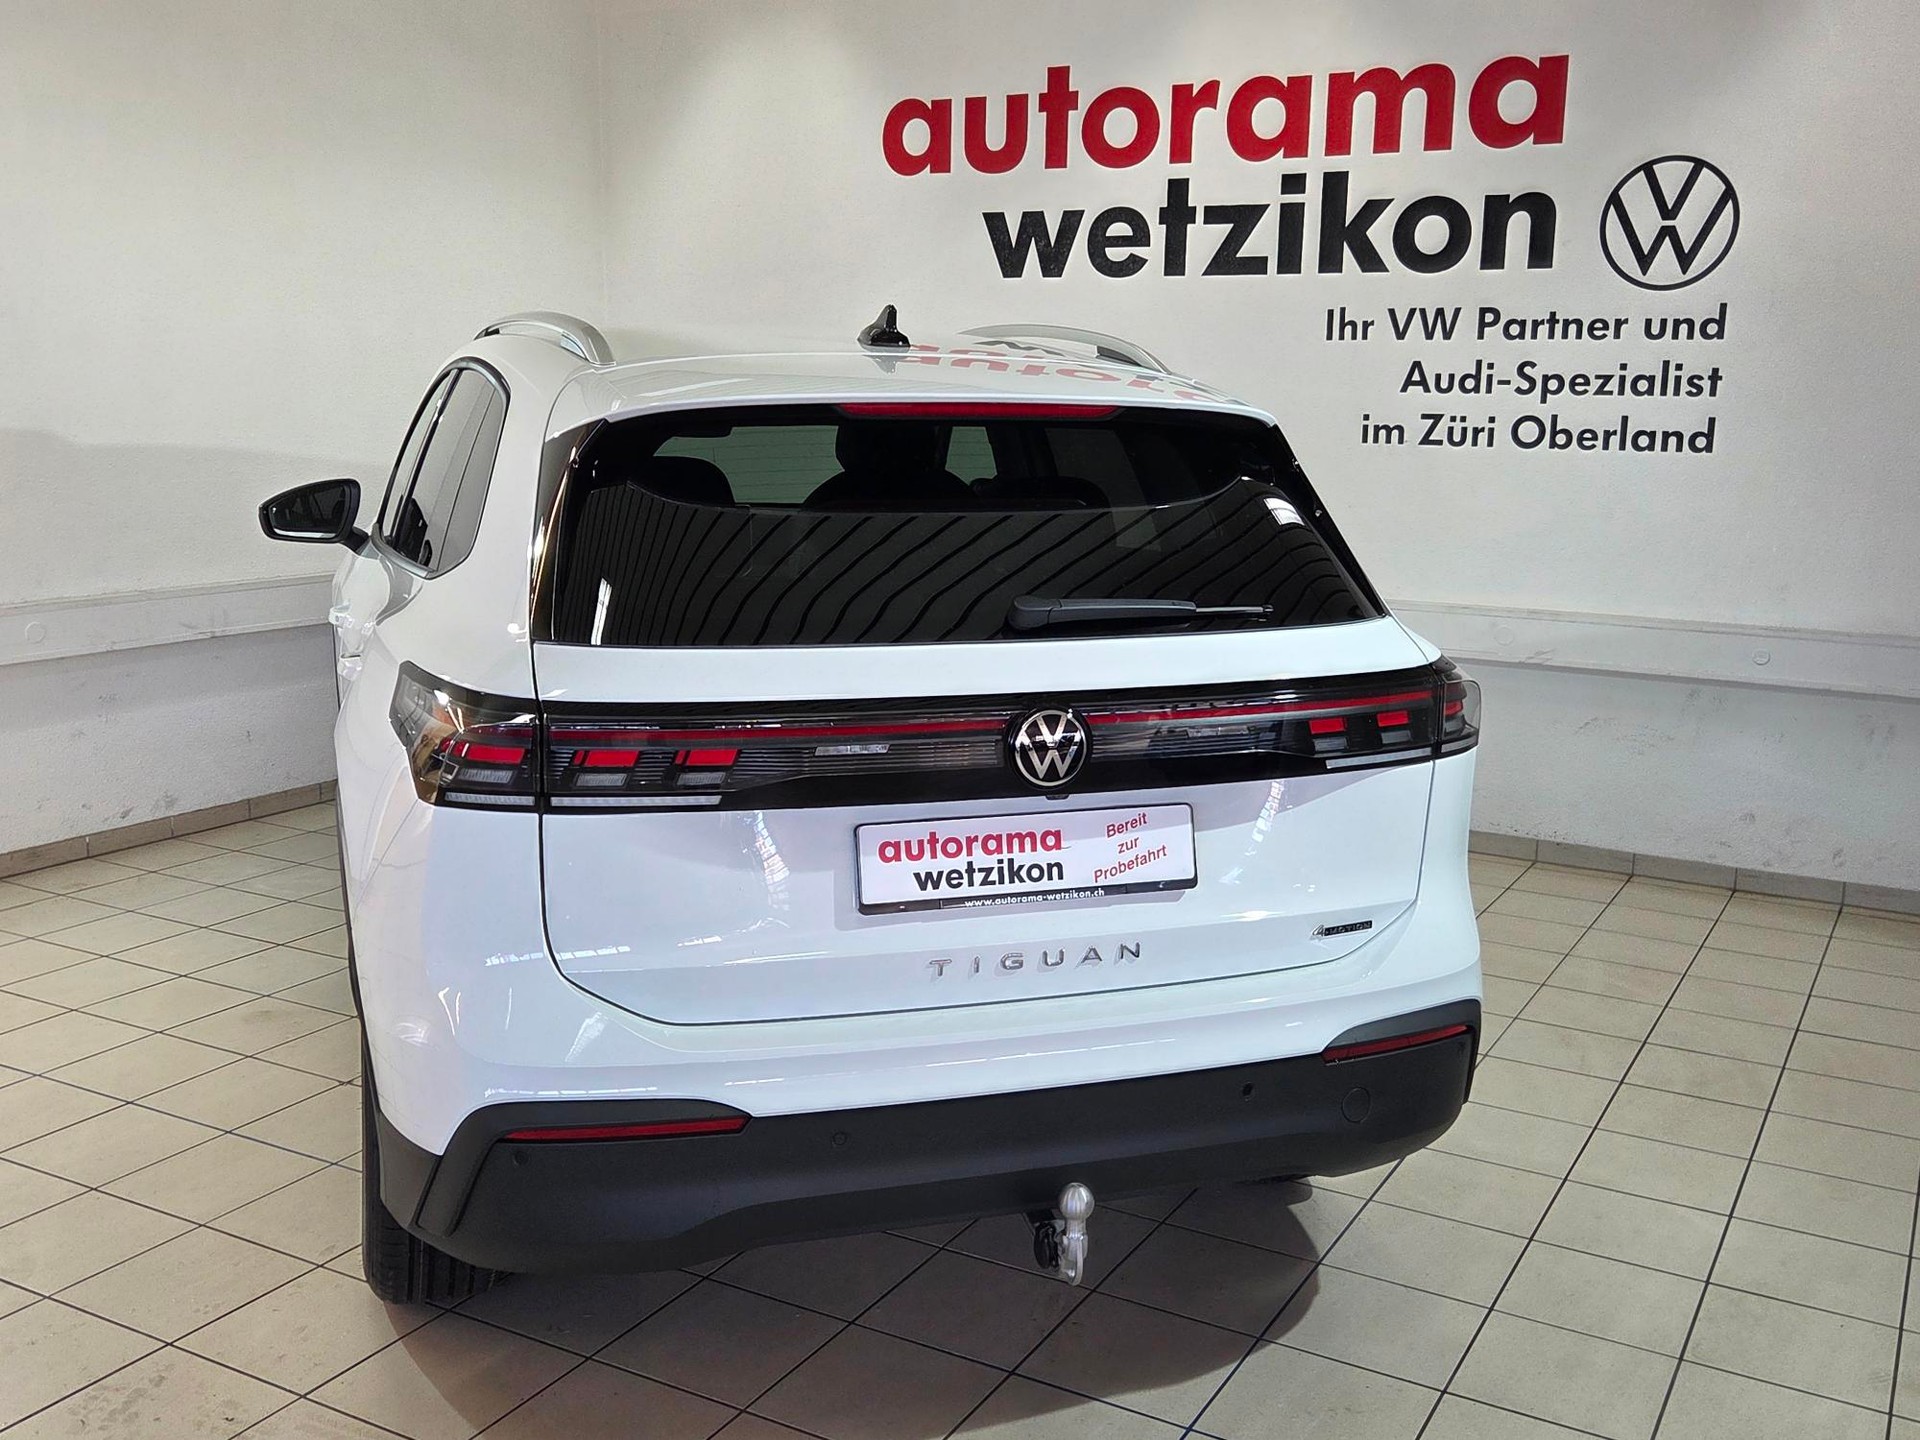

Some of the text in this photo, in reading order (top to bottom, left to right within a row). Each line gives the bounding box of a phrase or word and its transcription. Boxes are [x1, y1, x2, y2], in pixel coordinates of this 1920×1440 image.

[883, 55, 1568, 176] autorama
[982, 171, 1556, 279] wetzikon
[1326, 303, 1728, 341] Ihr VW Partner und
[1400, 360, 1723, 404] Audi-Spezialist
[1362, 414, 1717, 453] im Züri Oberland
[1105, 812, 1148, 839] Bereit
[878, 828, 1062, 864] autorama
[1093, 844, 1168, 883] Probefahrt
[1117, 836, 1140, 855] zur
[913, 858, 1064, 892] wetzikon
[964, 888, 1105, 907] www.autorama-wetzikon.ch
[930, 942, 1143, 977] TIGUAN
